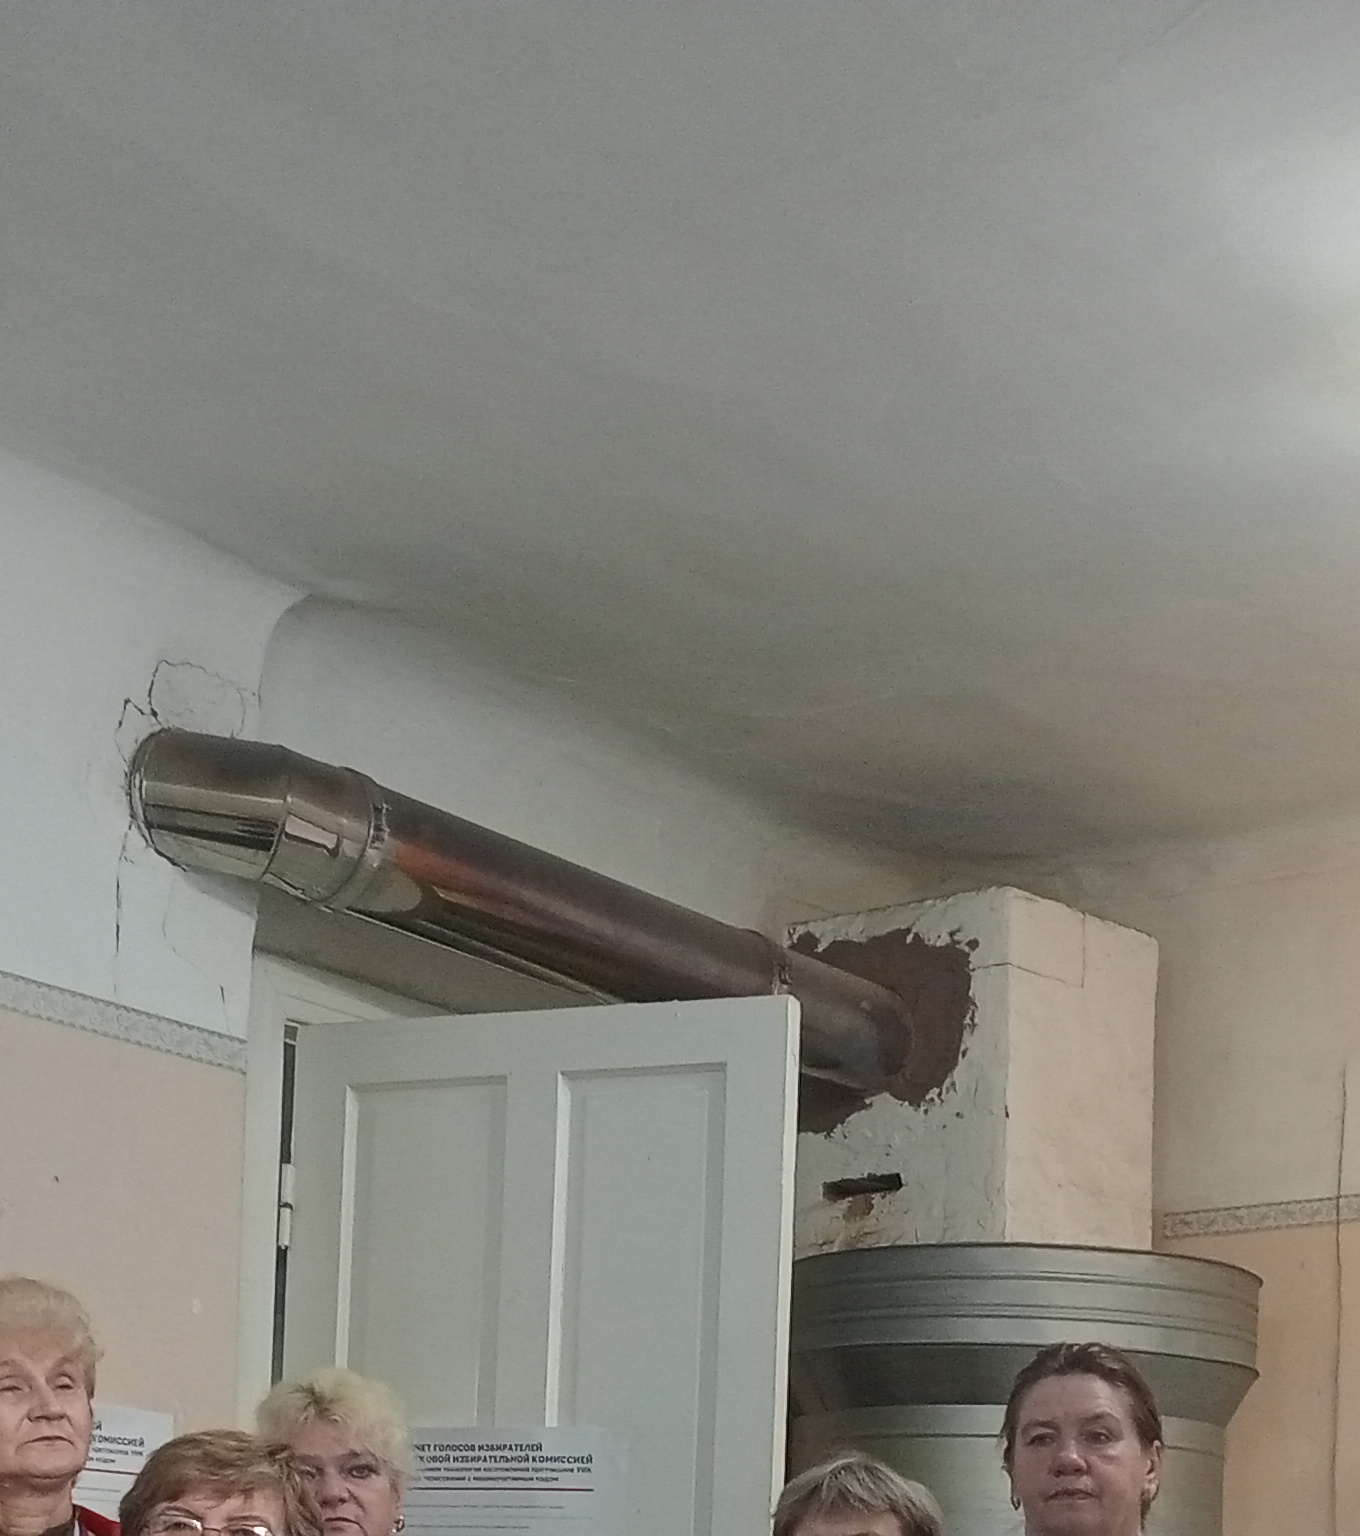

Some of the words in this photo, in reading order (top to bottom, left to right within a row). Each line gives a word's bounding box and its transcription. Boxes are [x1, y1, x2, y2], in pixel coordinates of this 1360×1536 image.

[433, 1443, 476, 1452] ГОЛОСОВ
[477, 1441, 543, 1452] ИЗБИРАТЕЛЕЙ
[452, 1453, 530, 1464] ИЗБИРАТЕЛЬНОЙ
[532, 1454, 593, 1465] КОМИССИЕЙ
